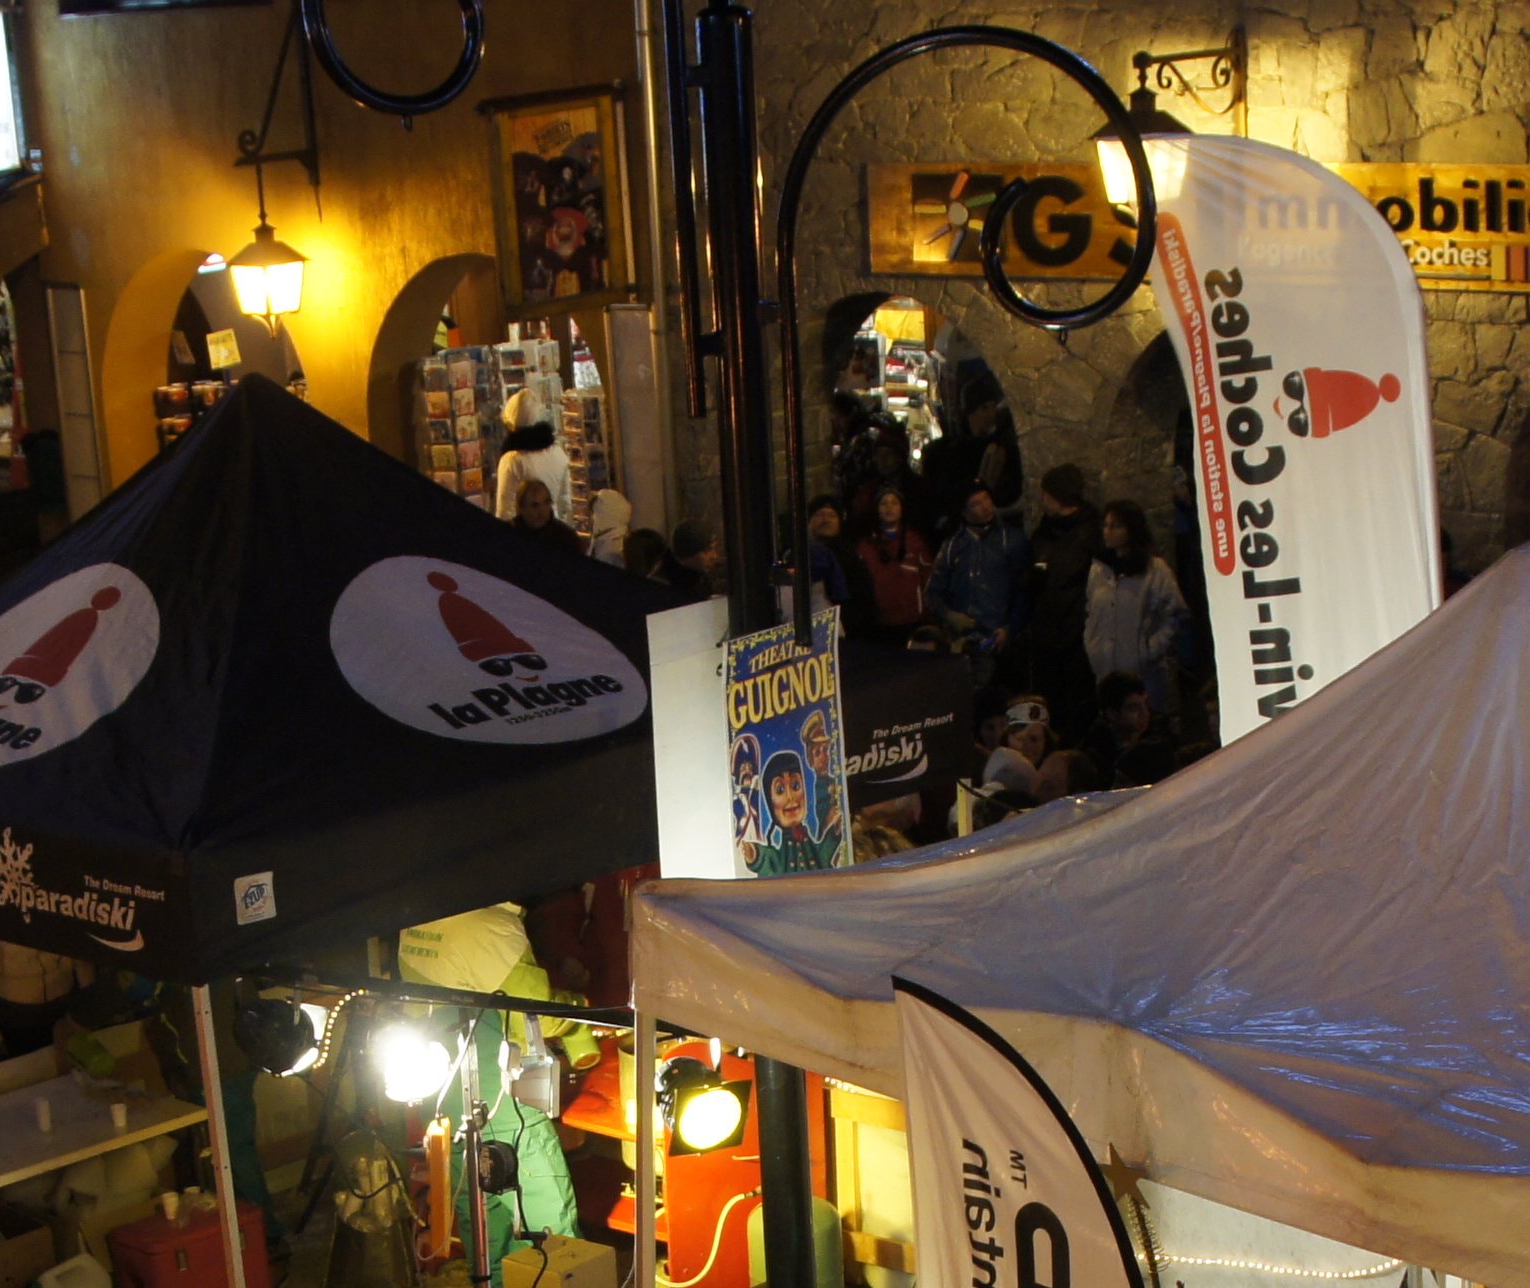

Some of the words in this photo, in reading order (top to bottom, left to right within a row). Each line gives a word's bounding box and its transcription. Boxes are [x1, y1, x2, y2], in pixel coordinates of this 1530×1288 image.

[471, 674, 623, 717] Plagne
[727, 652, 835, 730] GUIGNOL
[872, 729, 890, 740] The
[924, 712, 954, 728] Resort
[83, 874, 101, 889] The
[102, 879, 132, 894] Dream
